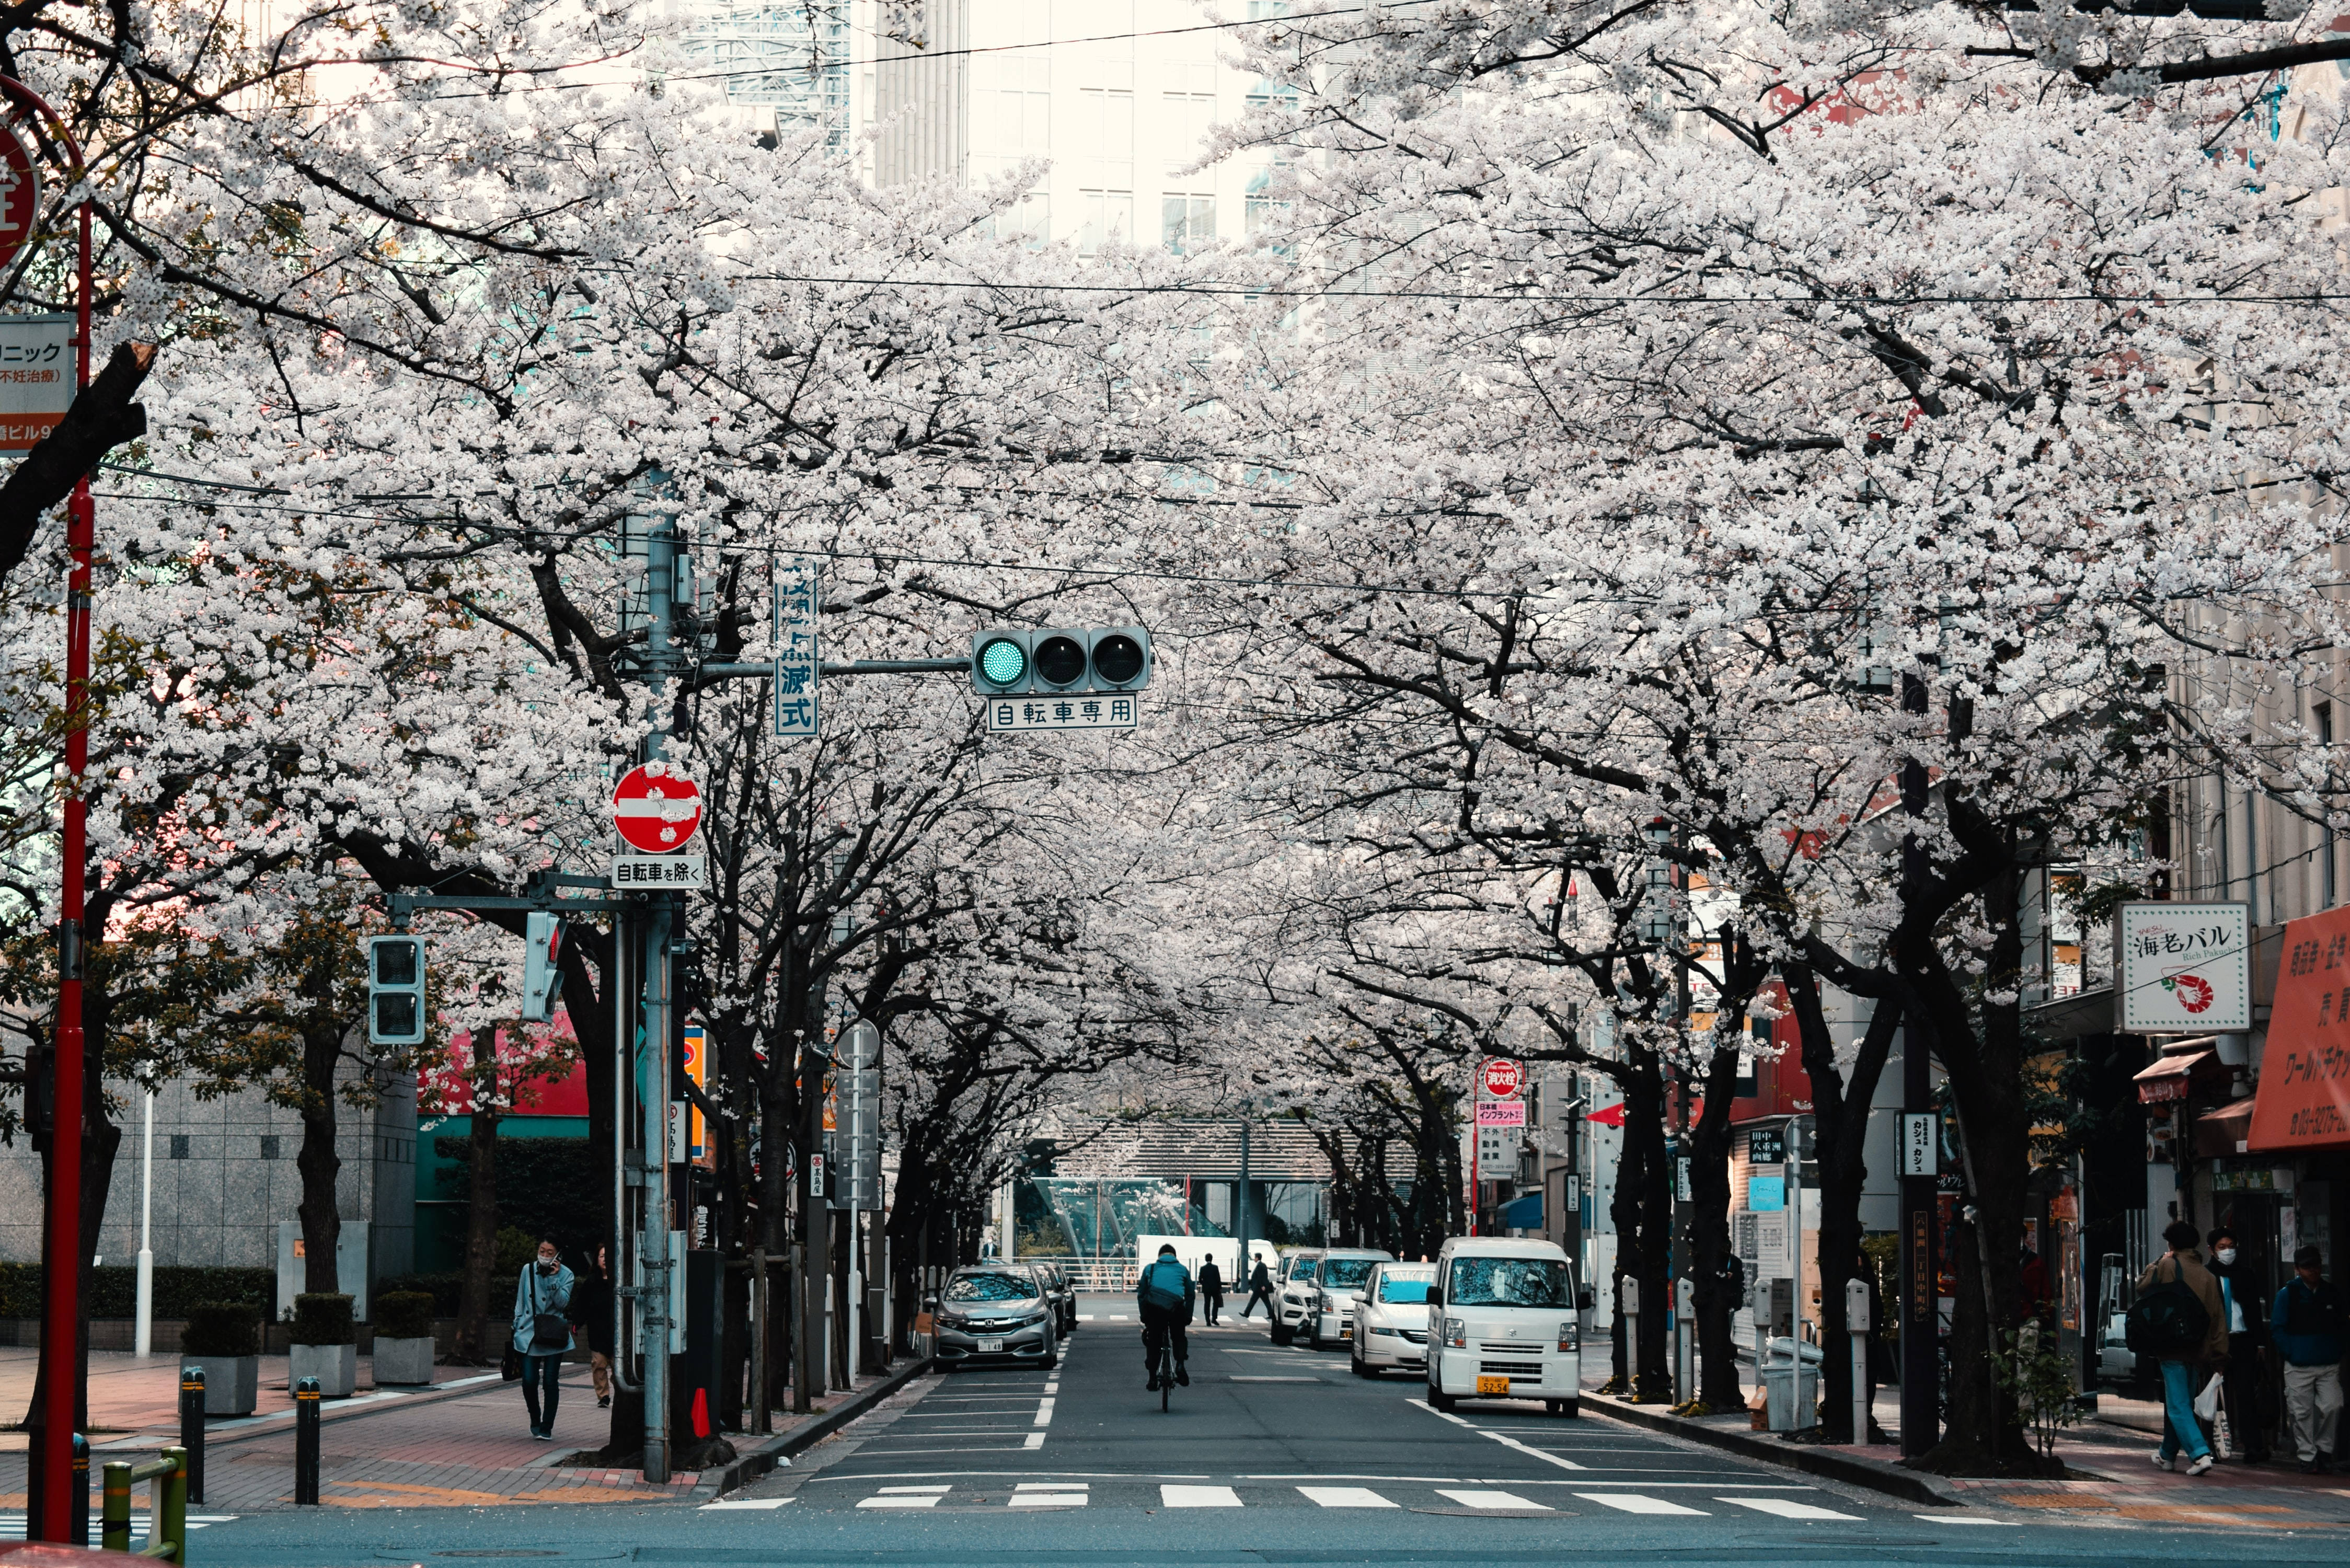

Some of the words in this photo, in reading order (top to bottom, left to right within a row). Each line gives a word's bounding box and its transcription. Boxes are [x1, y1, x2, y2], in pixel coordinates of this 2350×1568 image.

[0, 343, 61, 363] ニック
[0, 424, 55, 441] ビル9
[998, 700, 1131, 725] 自転車専用
[618, 863, 699, 882] 自転車を除く
[2134, 926, 2231, 959] 海老バル
[2182, 951, 2202, 961] Rich
[1488, 1071, 1516, 1086] 消火栓
[1753, 1132, 1771, 1140] 田中
[1753, 1142, 1781, 1151] 八重洲
[1484, 1383, 1507, 1392] 52-54
